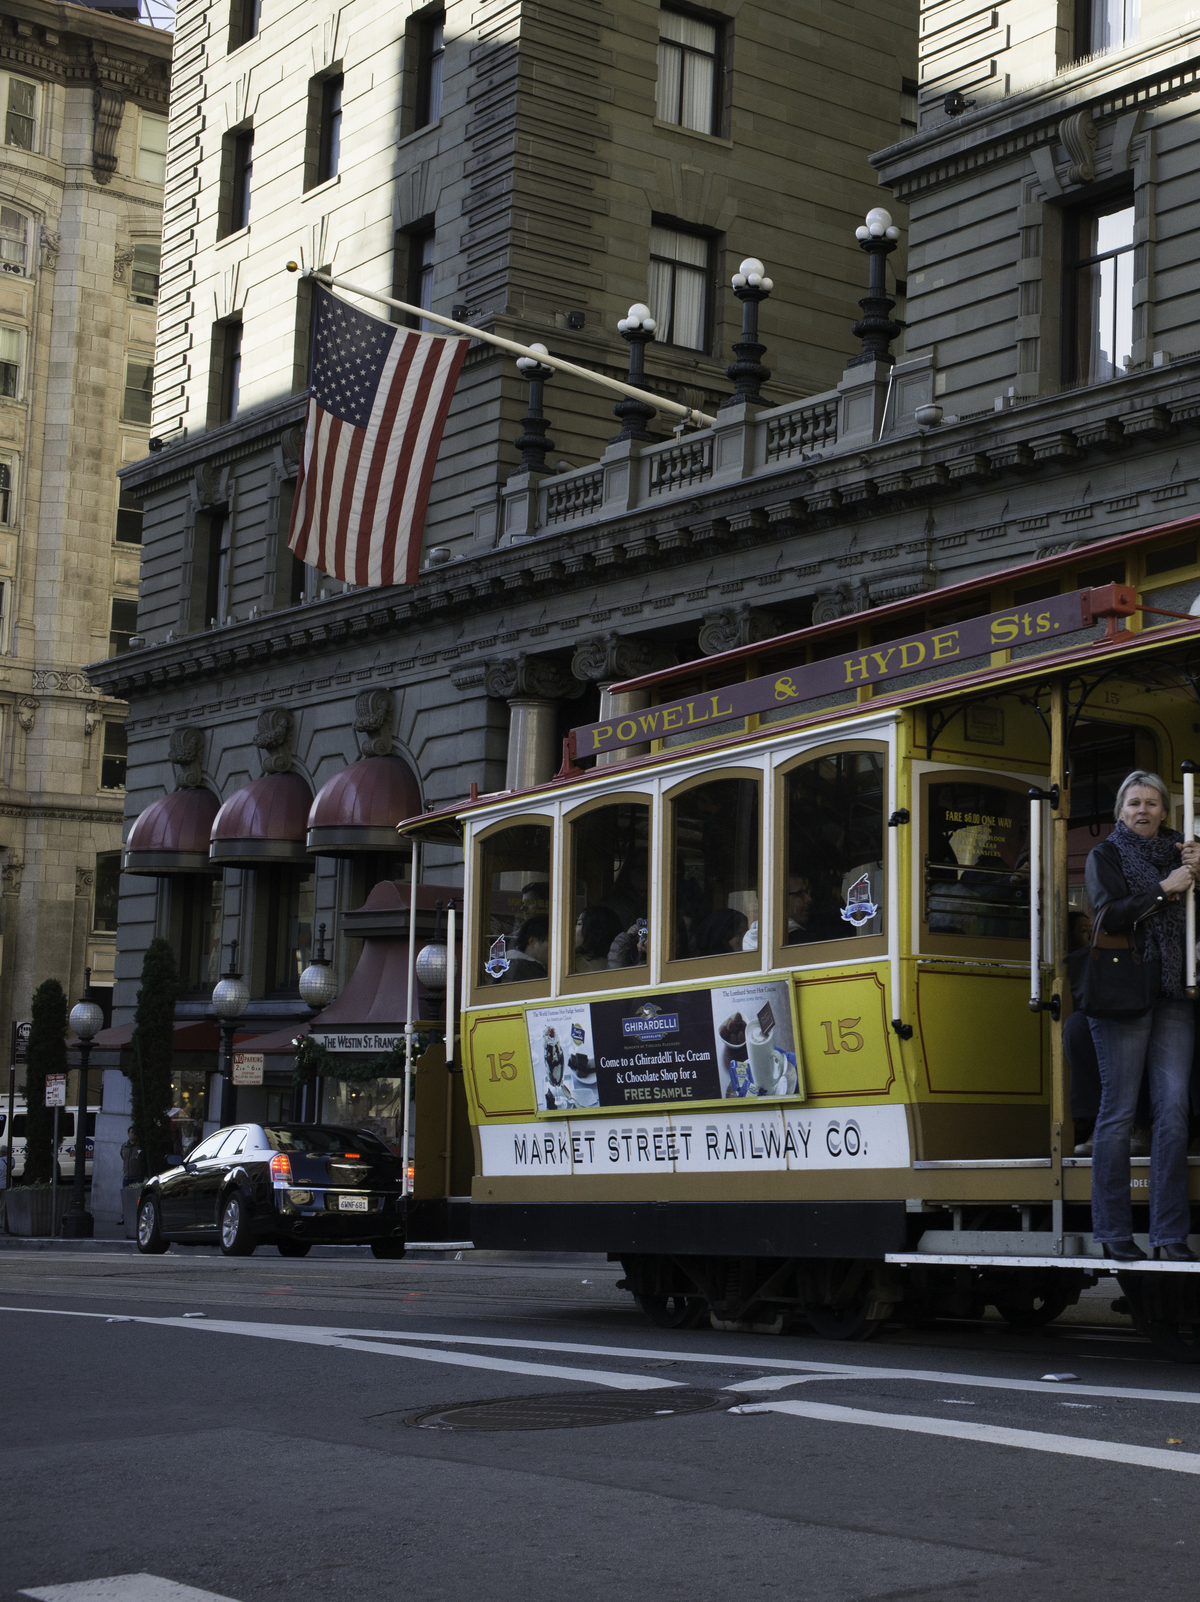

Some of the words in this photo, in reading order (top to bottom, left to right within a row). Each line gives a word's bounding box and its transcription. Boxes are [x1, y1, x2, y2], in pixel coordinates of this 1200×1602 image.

[591, 696, 733, 748] POWELL
[774, 676, 799, 701] &
[843, 630, 961, 684] HYDE
[989, 610, 1061, 646] Sts.
[1105, 690, 1120, 705] 15
[945, 810, 963, 822] FARE
[964, 812, 980, 824] $6.00
[981, 815, 996, 826] ONE
[997, 817, 1013, 829] WAY
[978, 841, 997, 849] CLEAR
[988, 835, 1006, 843] FLOOR
[968, 848, 1001, 857] TRANSFERS
[624, 1018, 677, 1033] GHIRARDELLI
[323, 1035, 336, 1049] THE
[337, 1035, 362, 1049] WESTIN
[363, 1035, 373, 1049] ST.
[374, 1035, 397, 1049] FRANC
[820, 1016, 865, 1056] 15
[234, 1054, 244, 1063] NO
[600, 1056, 620, 1068] Come
[620, 1058, 629, 1067] to
[635, 1051, 673, 1066] Ghirardelli
[674, 1051, 686, 1063] Ice
[686, 1050, 711, 1062] Cream
[486, 1051, 518, 1083] 15
[616, 1072, 624, 1084] &
[625, 1070, 660, 1083] Chocolate
[660, 1069, 679, 1083] Shop
[679, 1067, 690, 1080] for
[691, 1071, 697, 1079] a
[624, 1088, 652, 1101] FREE
[514, 1133, 595, 1165] MARKET
[608, 1129, 692, 1163] STREET
[705, 1125, 812, 1162] RAILWAY
[826, 1121, 868, 1158] CO.
[340, 1200, 366, 1210] 6WNF681
